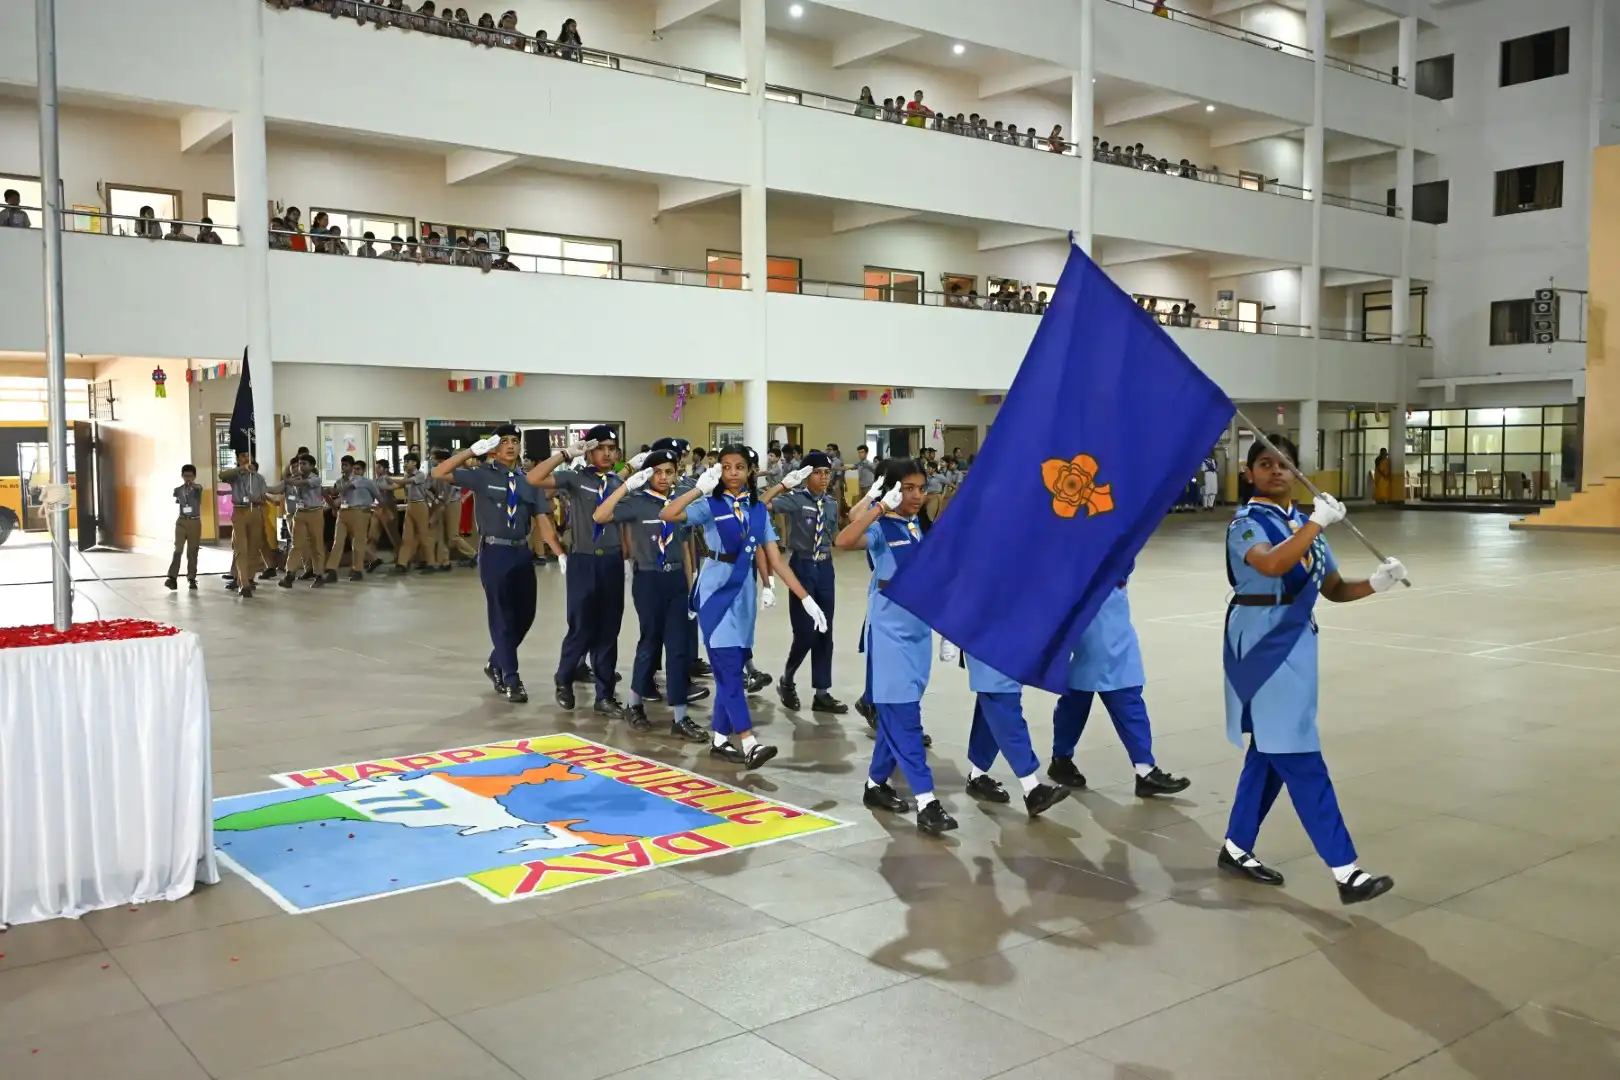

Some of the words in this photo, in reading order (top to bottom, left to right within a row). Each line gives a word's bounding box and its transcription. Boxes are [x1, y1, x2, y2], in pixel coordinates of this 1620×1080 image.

[287, 740, 534, 788] HAPPY
[543, 745, 803, 825] REPUBLIC
[356, 788, 449, 815] 77
[513, 832, 731, 894] DAY
